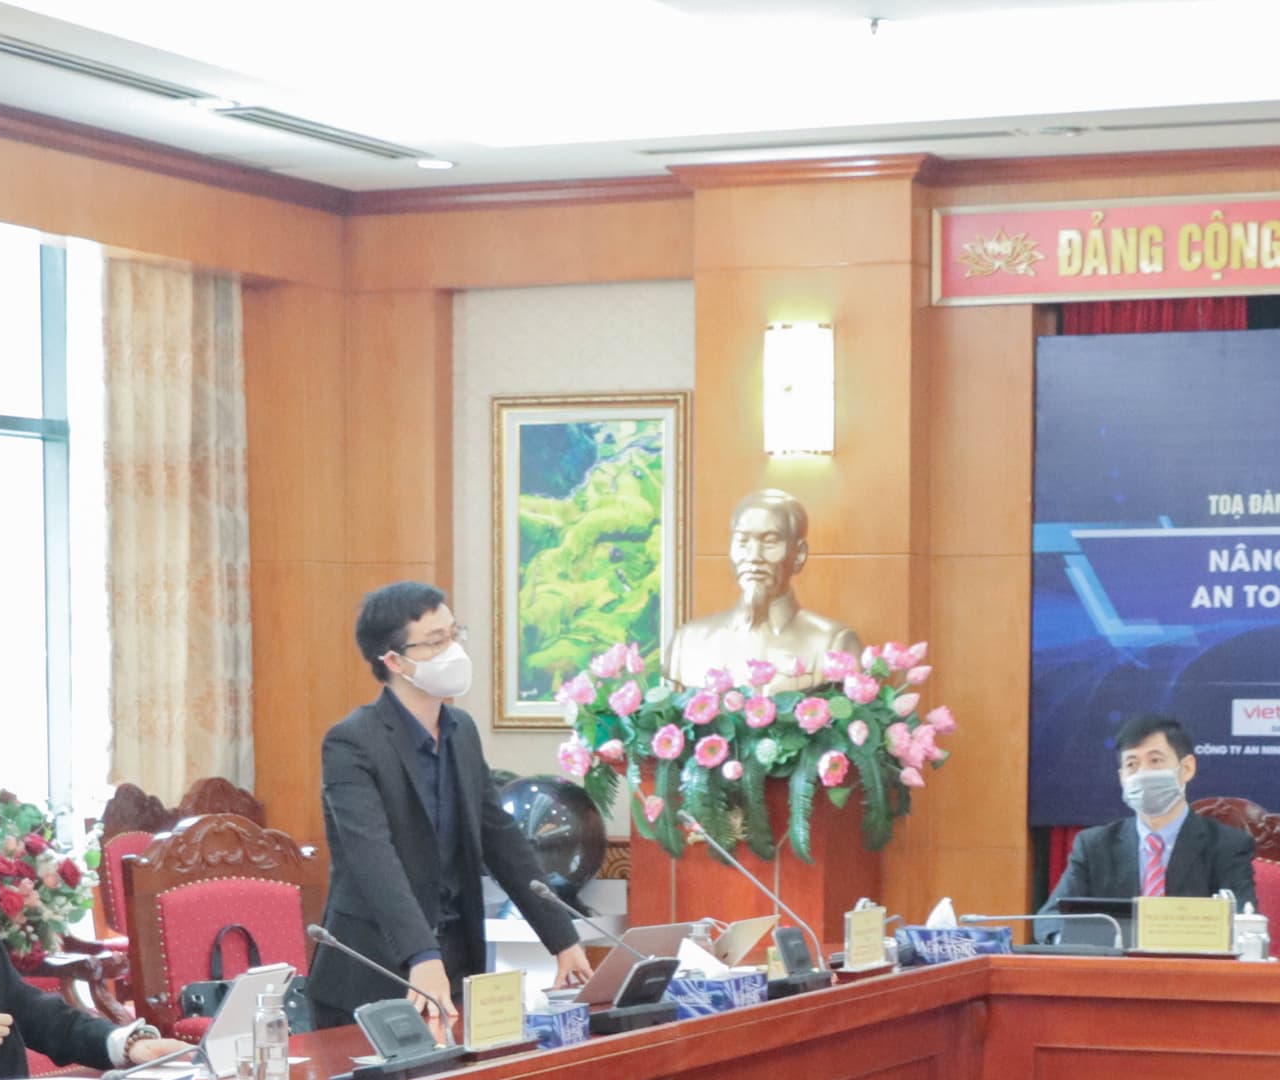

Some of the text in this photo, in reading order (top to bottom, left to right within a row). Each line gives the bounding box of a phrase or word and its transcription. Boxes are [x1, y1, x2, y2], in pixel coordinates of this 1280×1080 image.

[1057, 211, 1163, 277] ĐẢNG
[1208, 494, 1244, 519] TOẠ
[1191, 585, 1233, 609] AN
[1195, 743, 1228, 756] CÔNG
[1230, 745, 1242, 755] TY
[1243, 745, 1260, 755] AN
